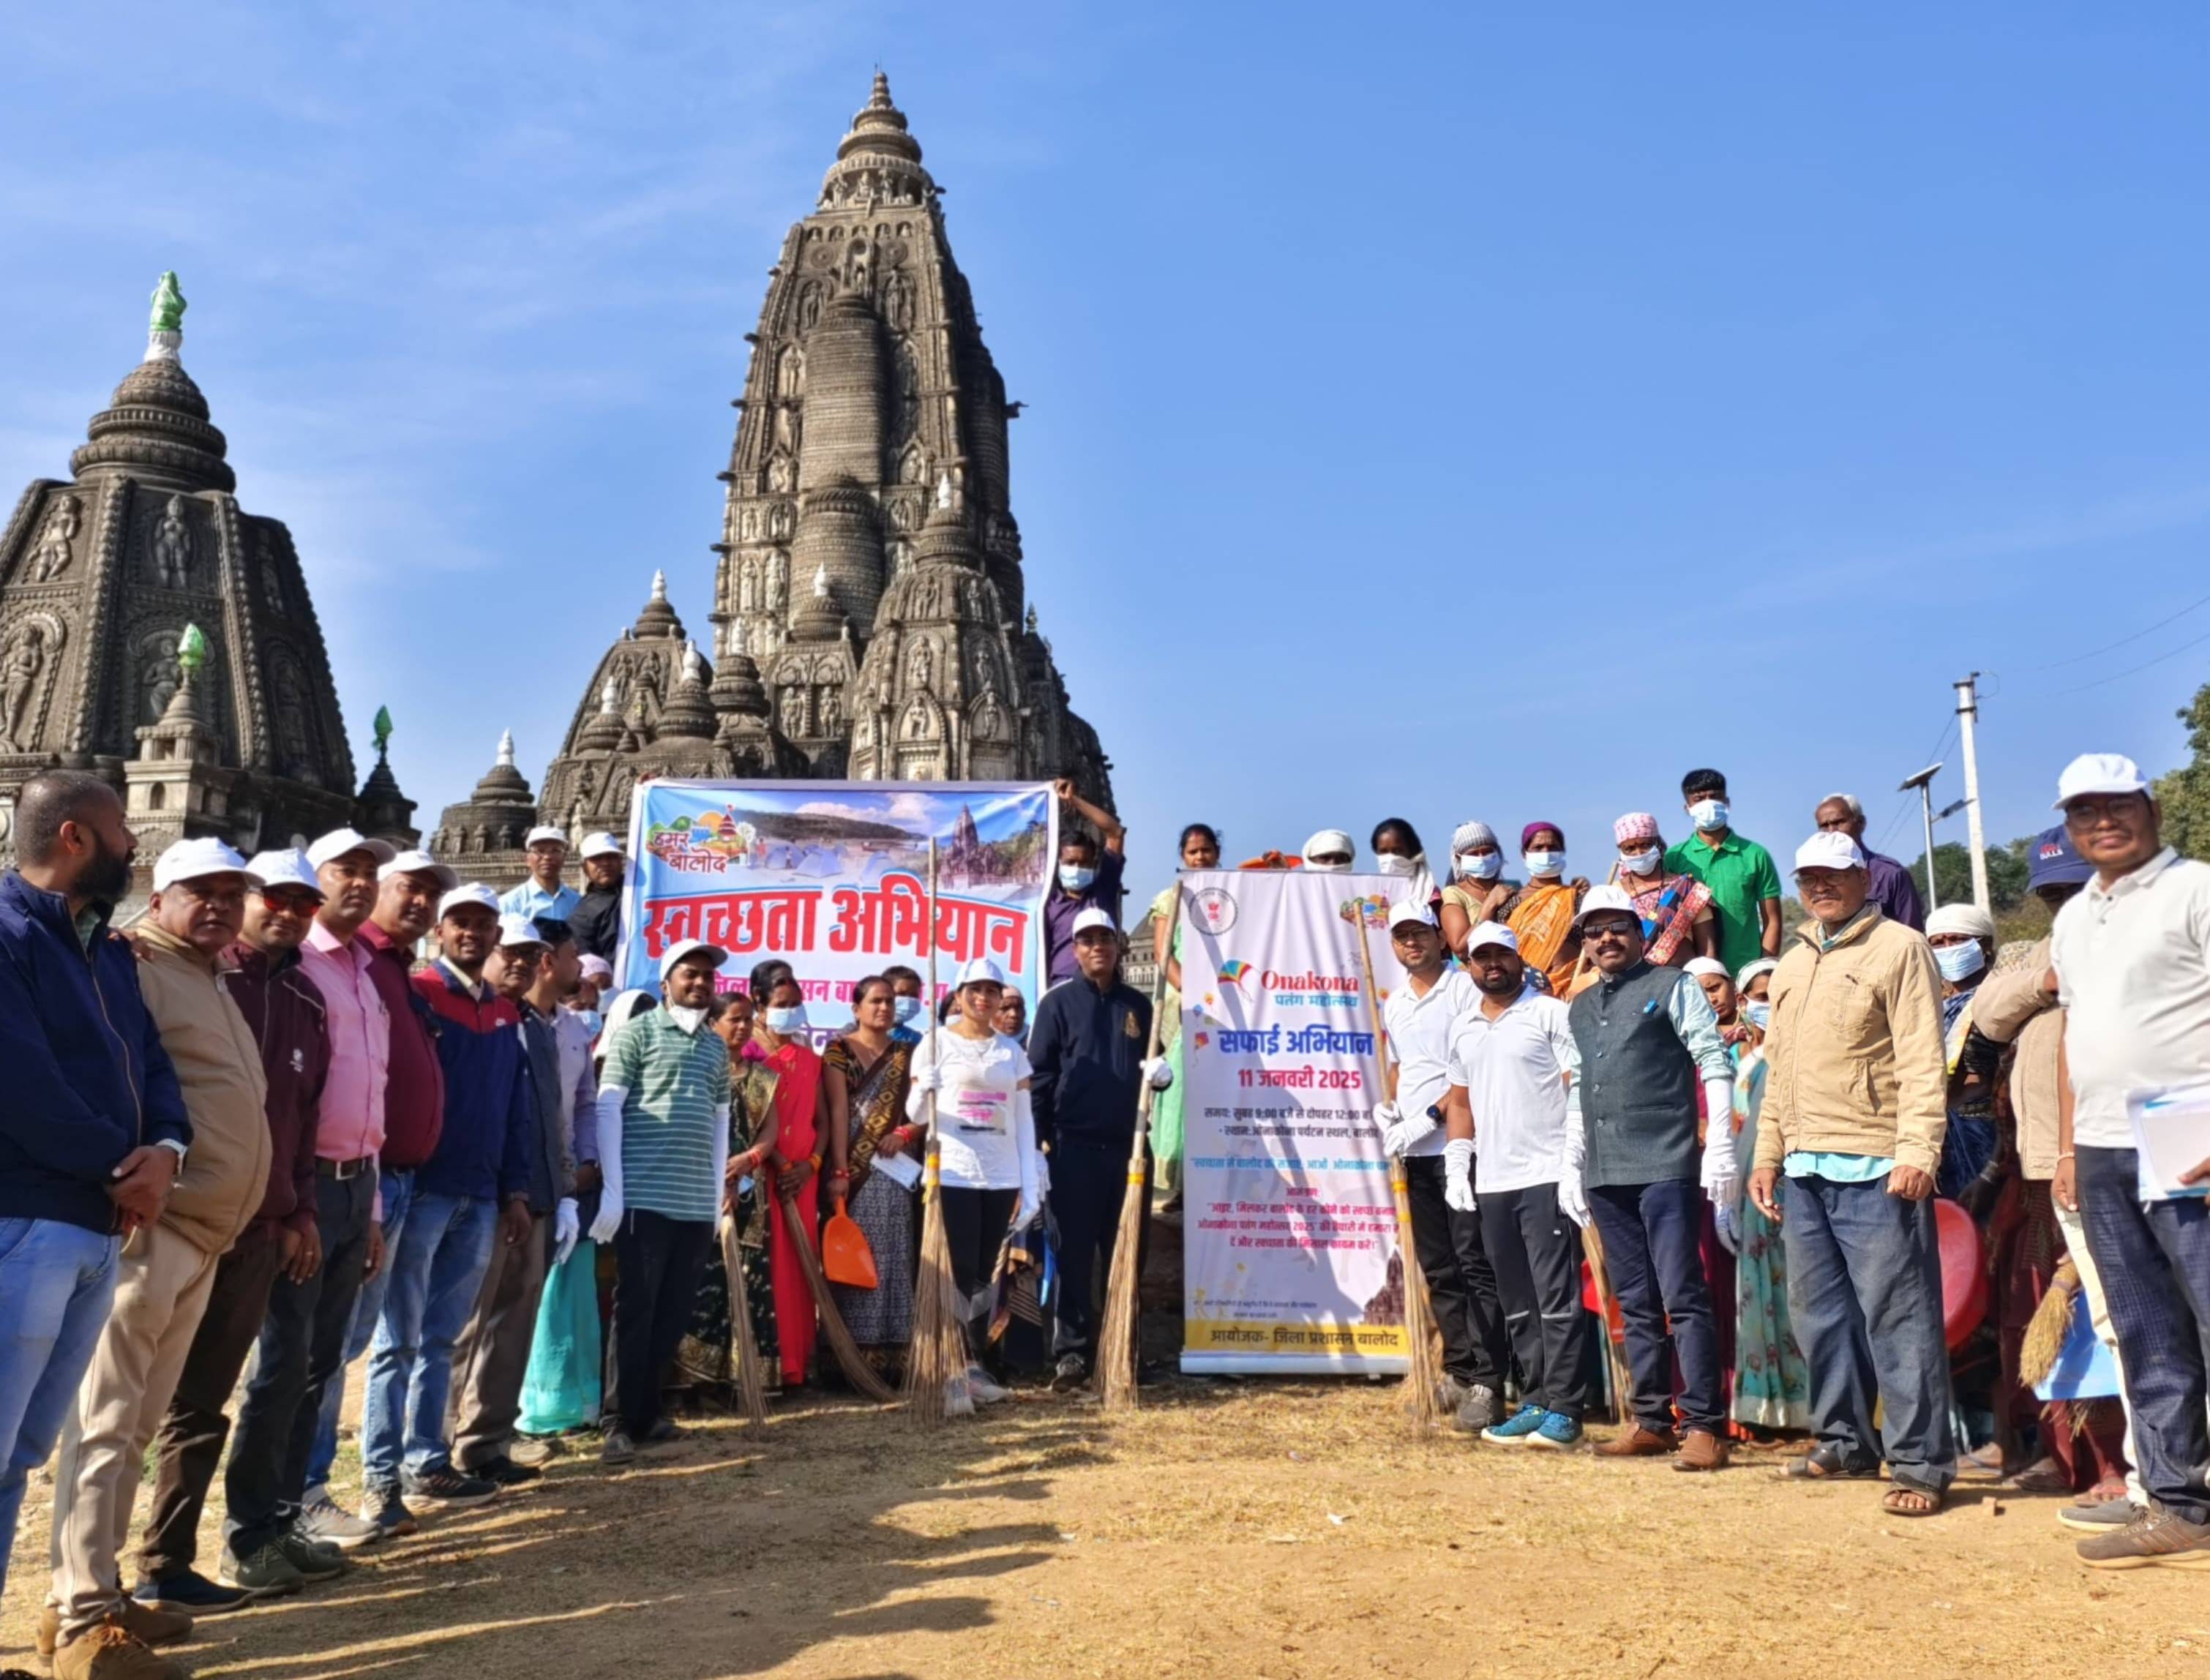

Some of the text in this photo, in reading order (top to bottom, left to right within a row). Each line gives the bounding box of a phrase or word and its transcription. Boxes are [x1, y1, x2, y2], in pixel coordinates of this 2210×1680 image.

[653, 831, 689, 847] हमर
[669, 847, 727, 873] बालोद
[643, 873, 1028, 974] स्वच्छता अभियान
[1261, 970, 1359, 991] Onakona
[1274, 992, 1358, 1008] पतंग महोत्सव
[1218, 1024, 1374, 1055] सफाई अभियान
[1238, 1065, 1361, 1089] 11 जनवरी 2025
[1255, 1108, 1277, 1119] 9:00
[1278, 1106, 1293, 1119] बजे
[1296, 1107, 1304, 1119] से
[1306, 1106, 1333, 1120] दोपहर
[1335, 1109, 1360, 1120] 12:00
[1297, 1125, 1324, 1137] पर्यटन
[1273, 1327, 1305, 1345] जिला
[1308, 1330, 1354, 1346] प्रशासन
[1357, 1330, 1398, 1346] बालोद
